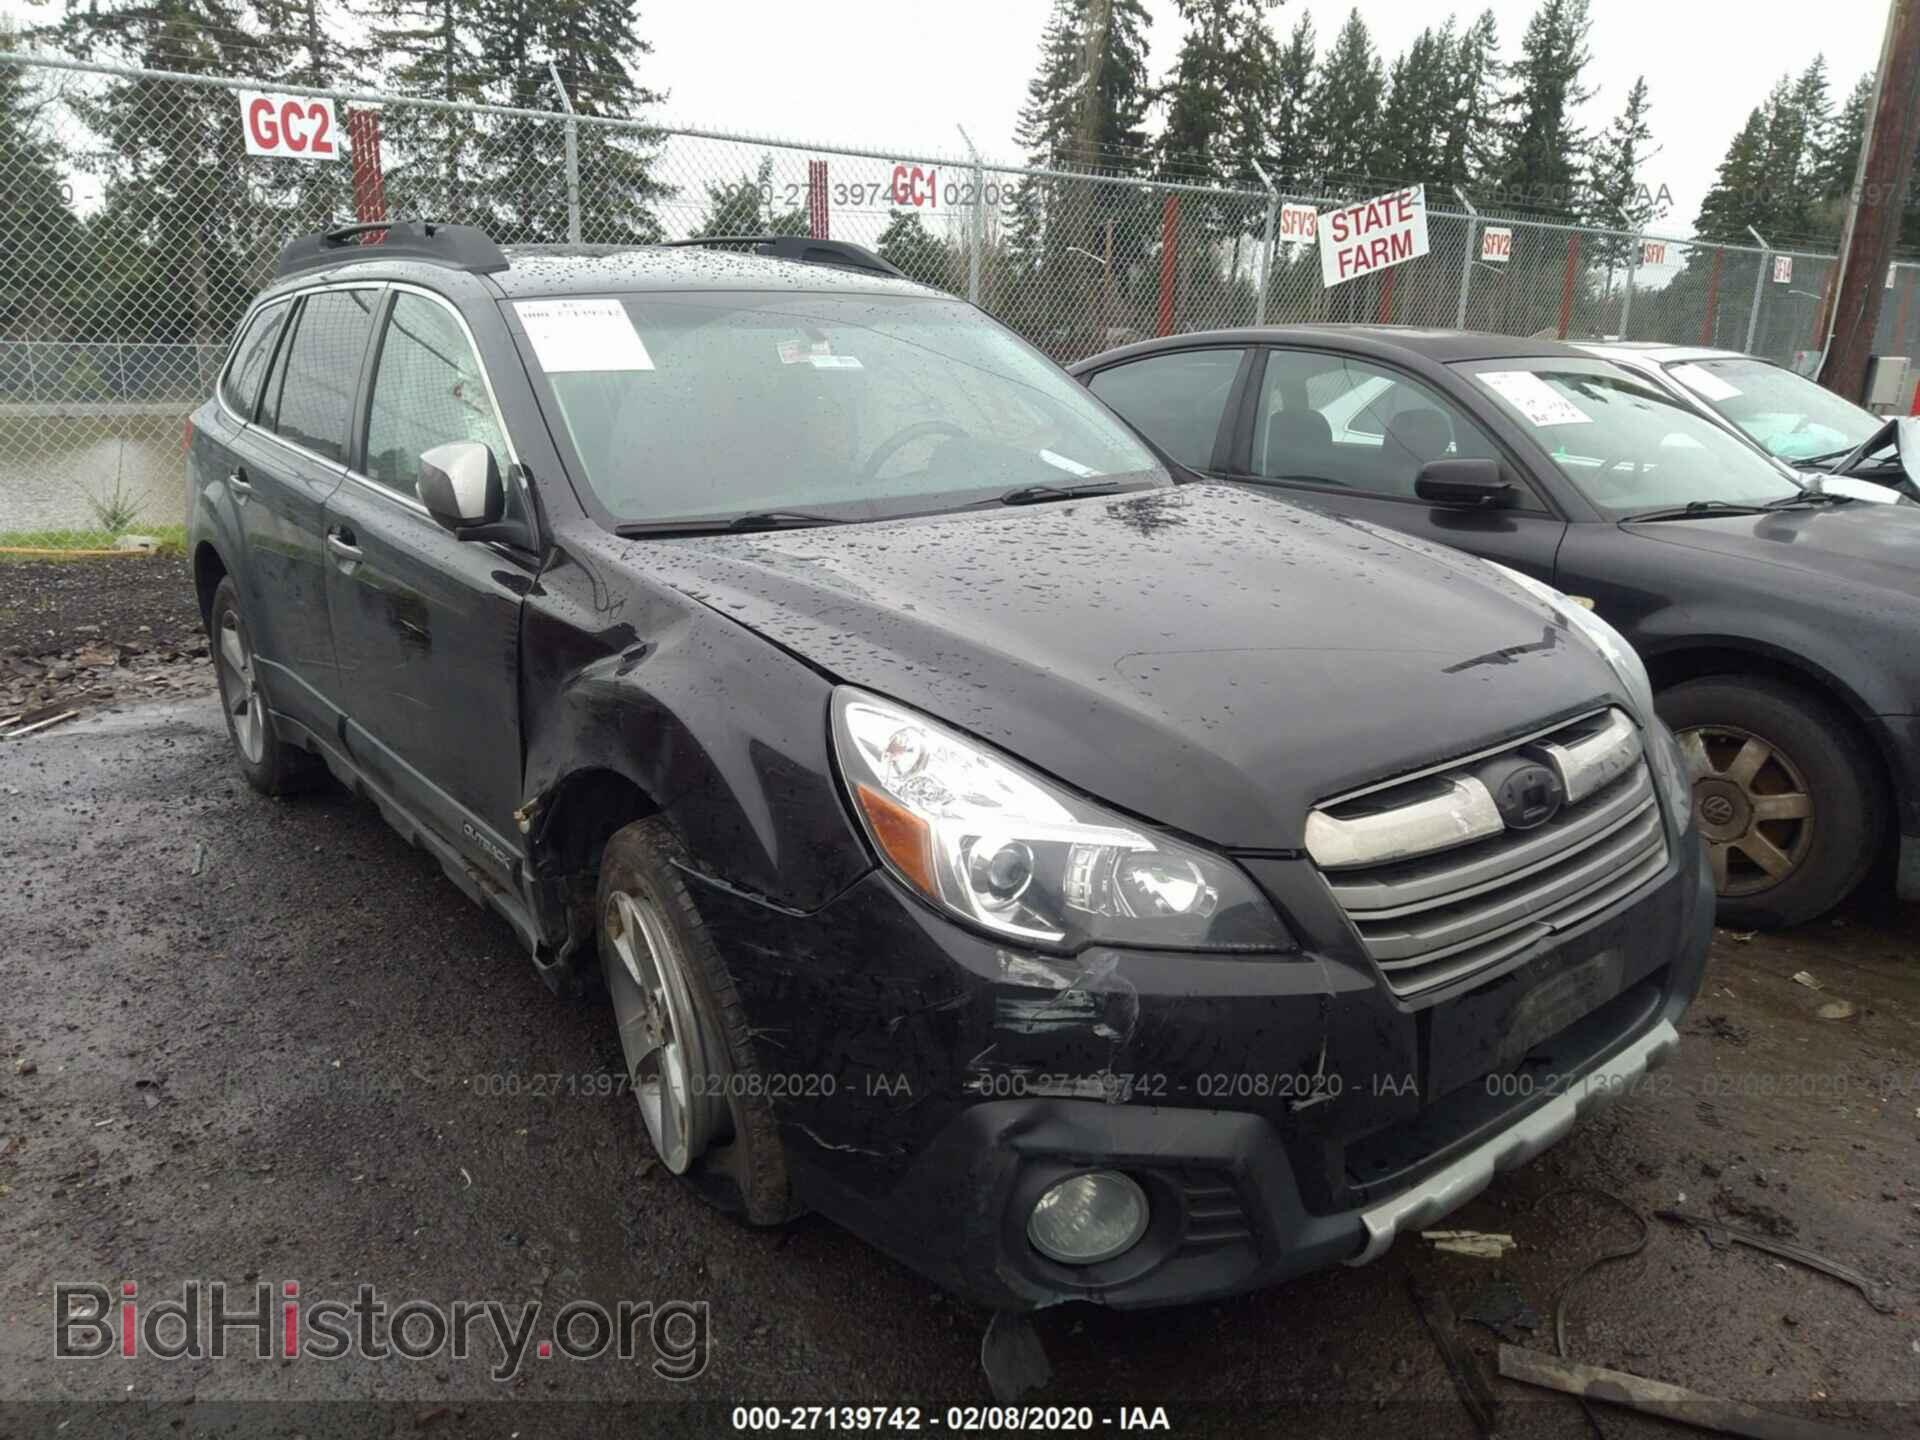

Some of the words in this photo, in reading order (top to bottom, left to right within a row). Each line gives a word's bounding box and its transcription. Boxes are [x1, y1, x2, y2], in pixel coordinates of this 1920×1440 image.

[248, 98, 333, 153] GC2
[892, 165, 936, 208] GC1
[1282, 208, 1316, 237] SFV3
[1332, 192, 1414, 242] STATE
[1338, 229, 1413, 278] FARM
[1484, 233, 1511, 256] SFV2
